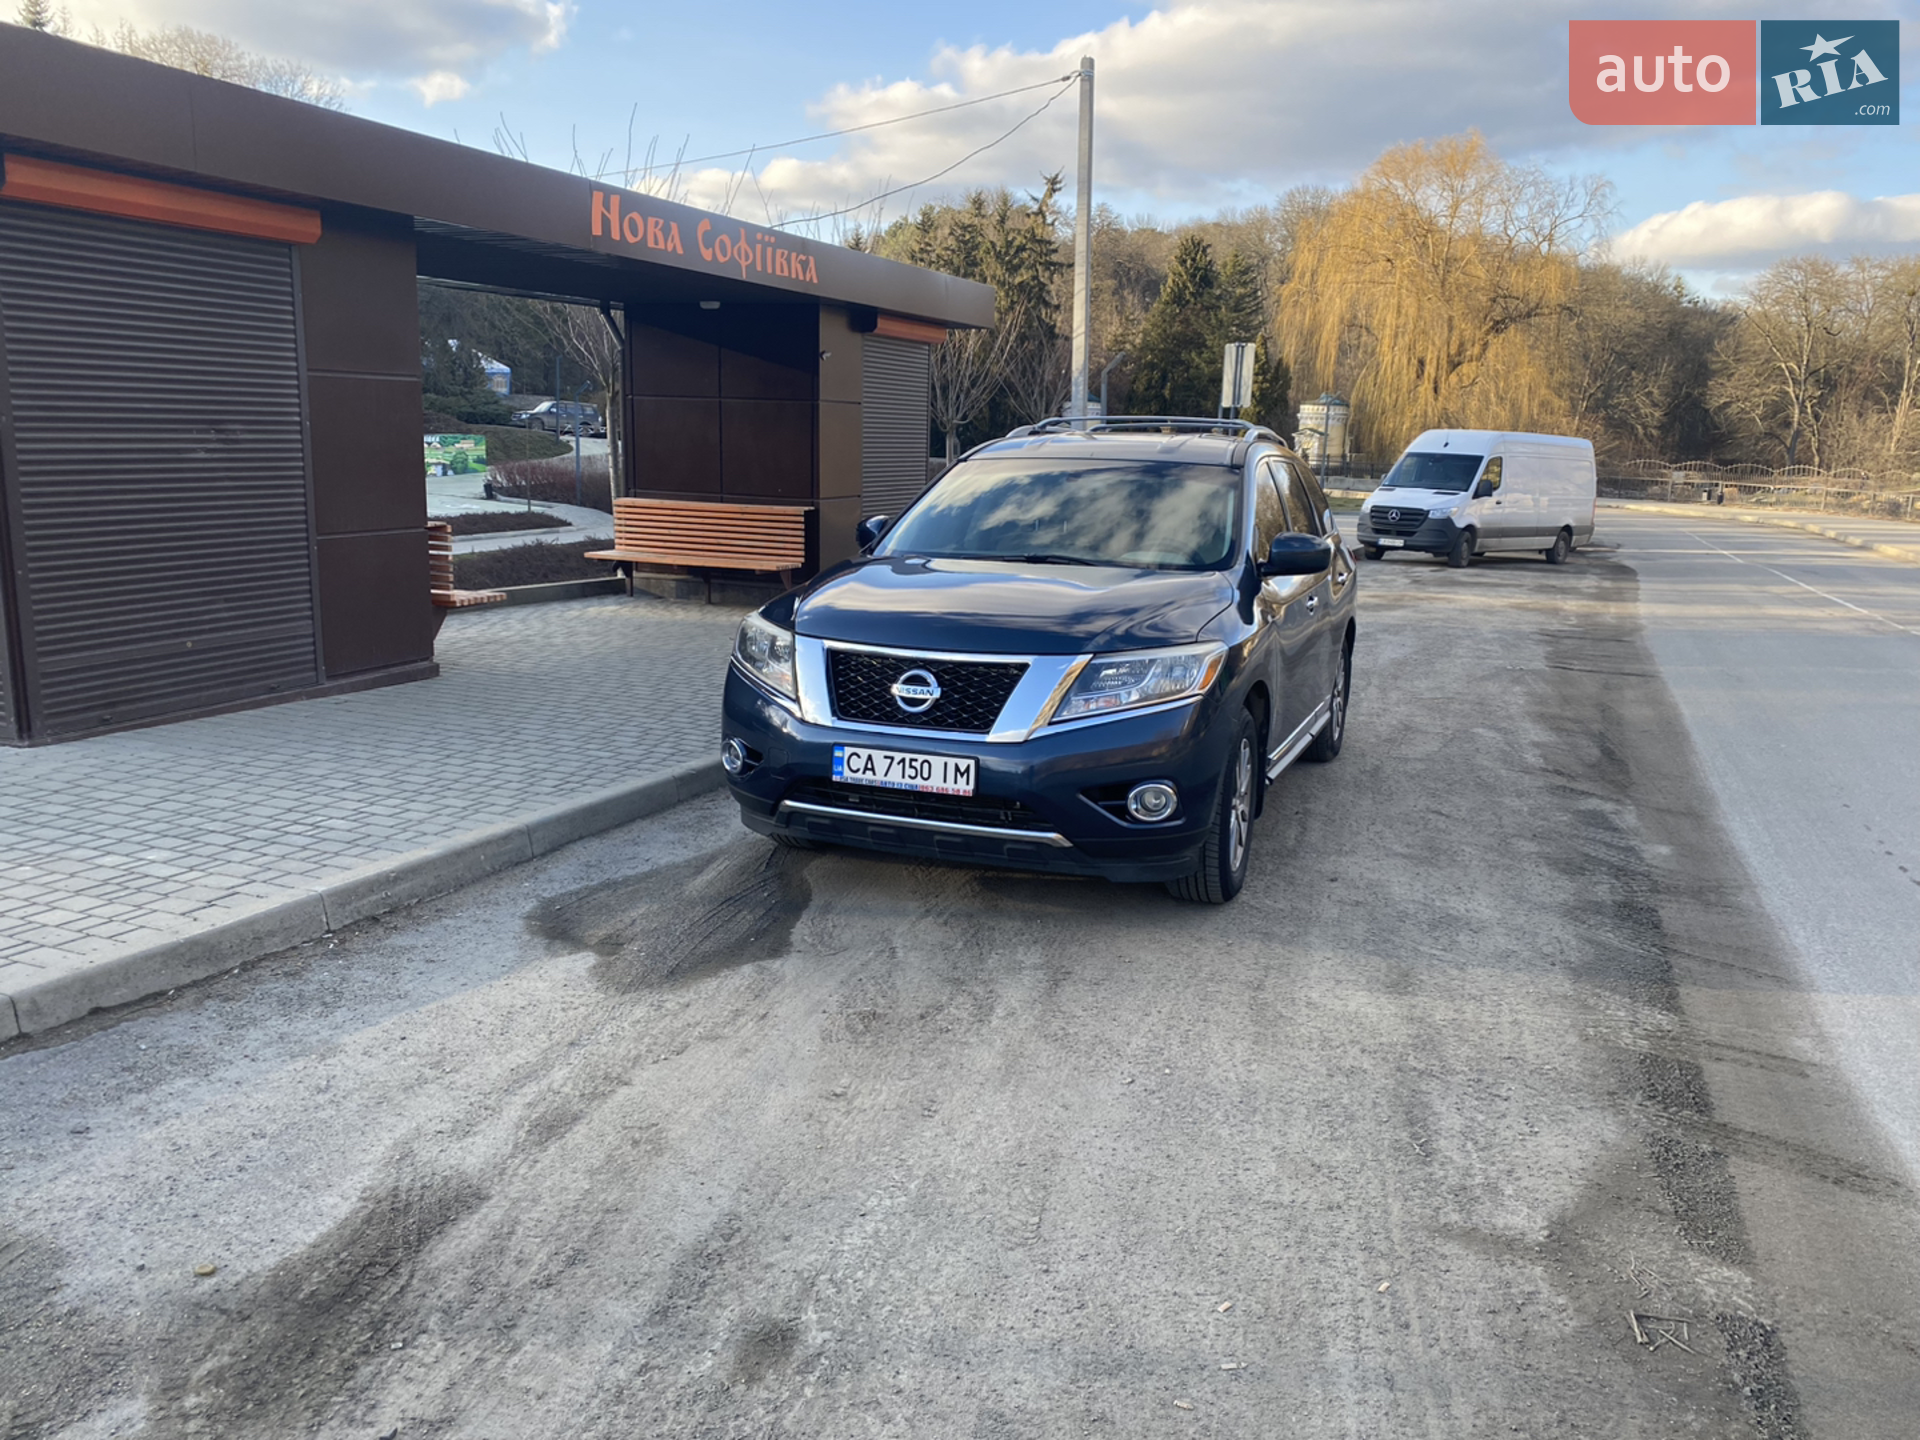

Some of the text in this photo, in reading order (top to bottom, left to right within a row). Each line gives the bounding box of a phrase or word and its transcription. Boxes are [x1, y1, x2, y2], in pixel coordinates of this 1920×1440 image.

[591, 190, 819, 284] Нова Софіївка
[896, 687, 934, 697] NISSAN
[846, 752, 971, 786] CA 7150 IM
